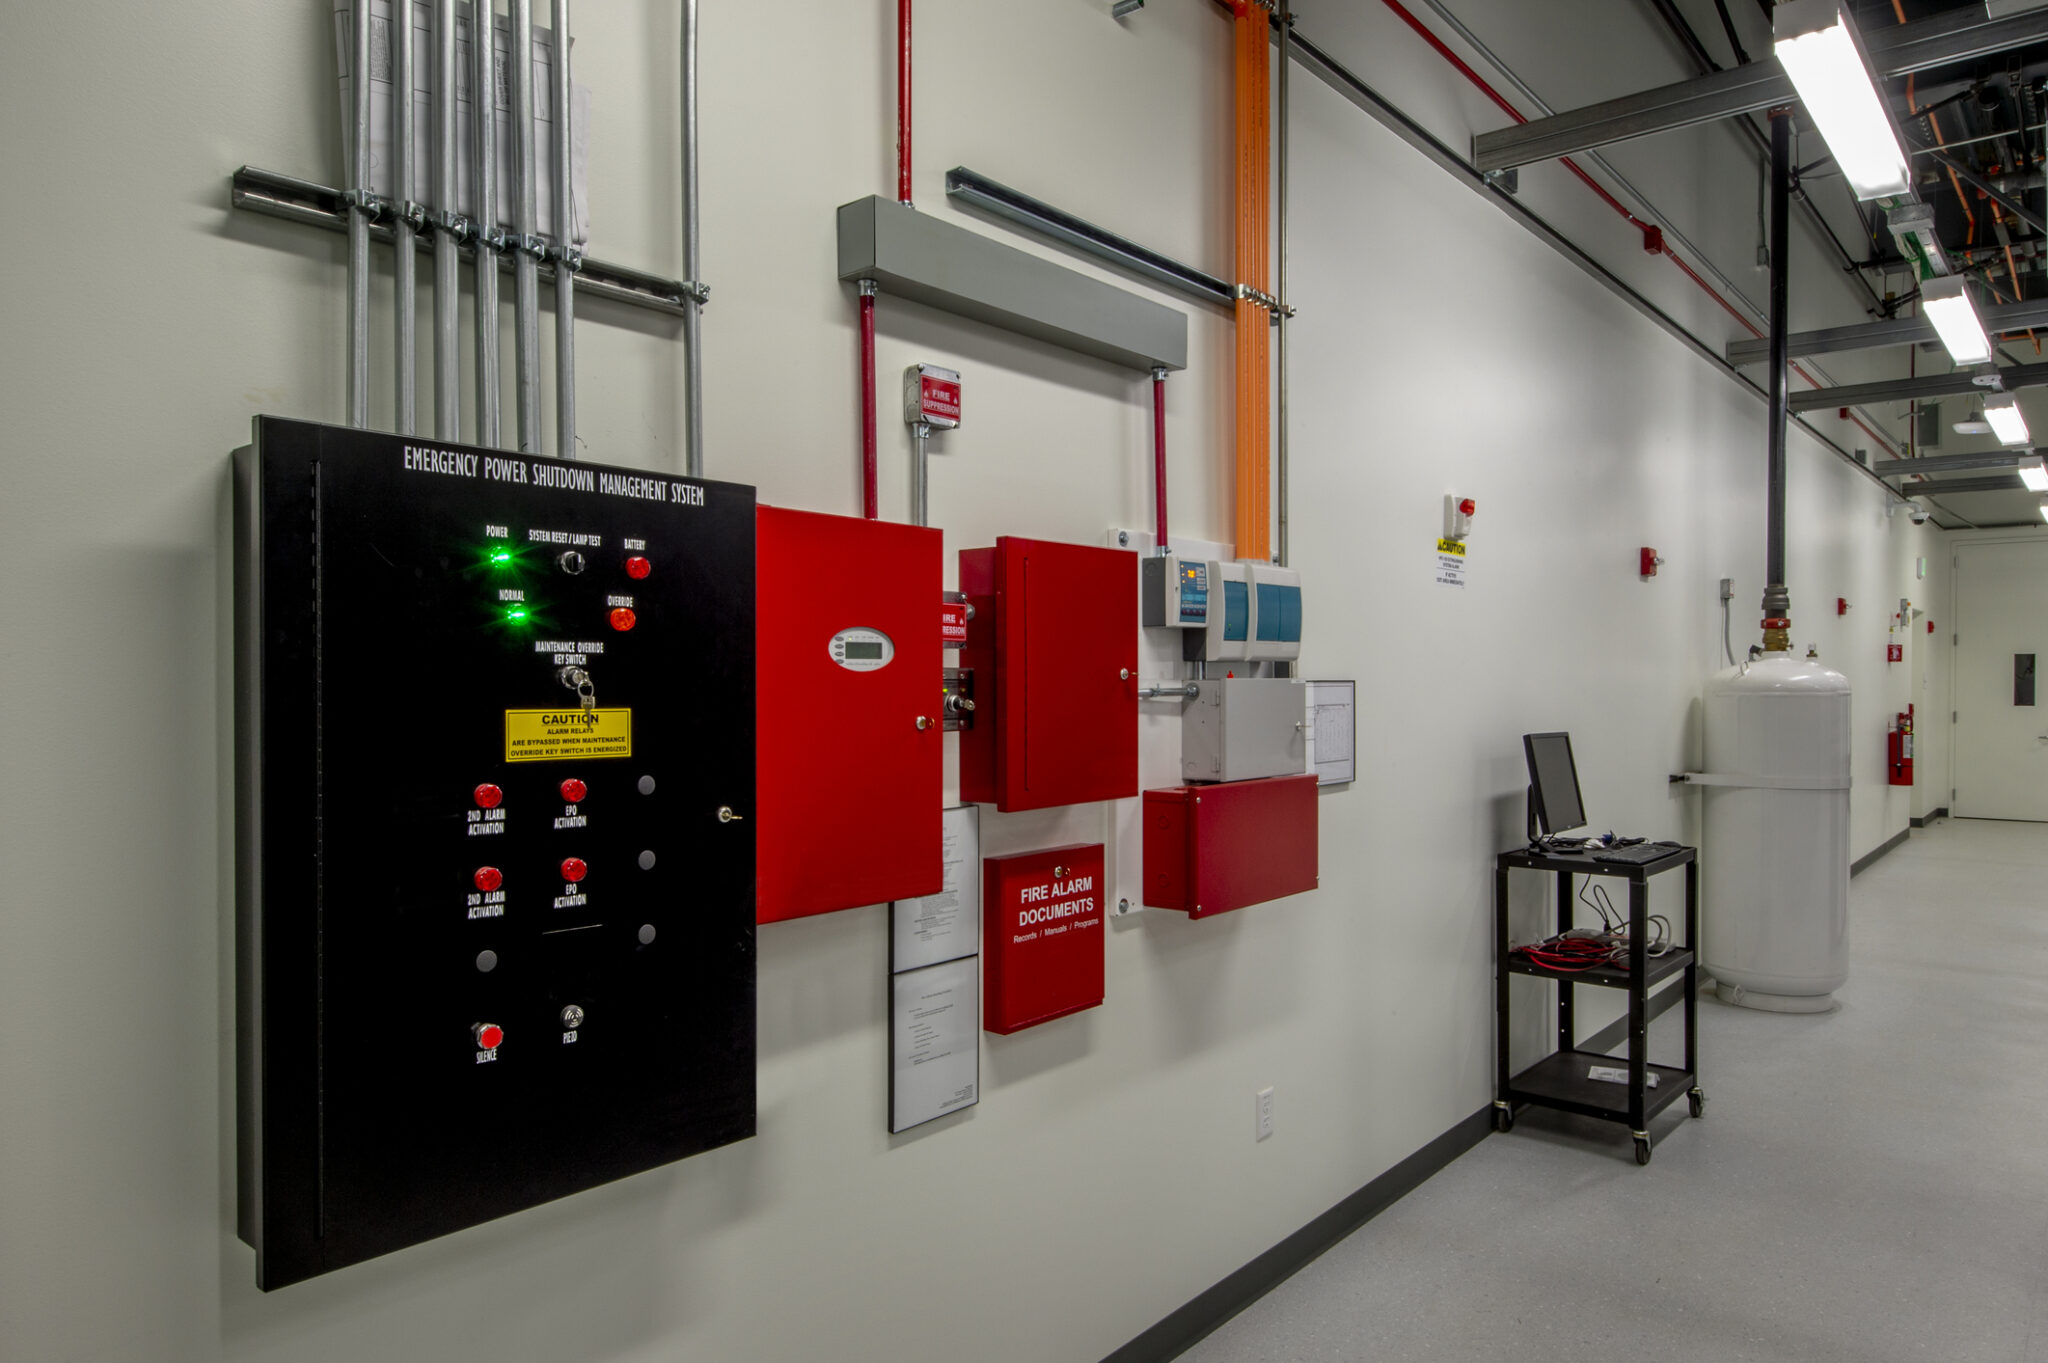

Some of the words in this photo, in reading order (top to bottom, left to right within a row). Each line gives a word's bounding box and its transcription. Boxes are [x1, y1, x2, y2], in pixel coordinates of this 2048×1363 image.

[932, 389, 950, 401] FIRE
[923, 399, 959, 414] SUPPRESSION
[404, 446, 478, 477] EMERGENCY
[485, 457, 528, 484] POWER
[533, 463, 594, 492] SHUTDOWN
[600, 473, 667, 501] MANAGEMENT
[671, 482, 704, 506] SYSTEM
[486, 525, 508, 538] POWER
[529, 529, 550, 542] SYSTEM
[552, 532, 567, 544] RESET
[573, 534, 587, 546] LAMP
[589, 535, 601, 546] TEST
[624, 538, 646, 550] BATTERY
[1443, 541, 1465, 555] CAUTION
[499, 589, 525, 601] NORMAL
[607, 595, 633, 607] OVERRIDE
[943, 613, 956, 624] IRE
[943, 625, 965, 636] RESSION
[535, 641, 575, 653] MAINTENANCE
[577, 642, 604, 653] OVERRIDE
[554, 654, 565, 664] KEY
[566, 654, 587, 665] SWITCH
[542, 714, 599, 724] CAUTION
[547, 727, 569, 735] ALARM
[527, 738, 560, 746] BYPASSED
[582, 736, 626, 744] MAINTENANCE
[511, 749, 543, 757] OVERRIDE
[593, 745, 627, 753] ENERGIZED
[467, 810, 481, 822] 2ND
[484, 808, 506, 821] ALARM
[565, 805, 577, 816] EPO
[468, 822, 505, 836] ACTIVATION
[554, 816, 587, 829] ACTIVATION
[565, 883, 577, 895] EPO
[1020, 884, 1049, 904] FIRE
[1051, 876, 1093, 898] ALARM
[467, 893, 481, 906] 2ND
[484, 891, 506, 904] ALARM
[554, 894, 587, 909] ACTIVATION
[468, 905, 504, 919] ACTIVATION
[1019, 897, 1094, 927] DOCUMENTS
[1013, 931, 1038, 944] Records
[1044, 924, 1067, 937] Manuals
[1074, 918, 1099, 930] Programs
[476, 1049, 497, 1064] SILENCE
